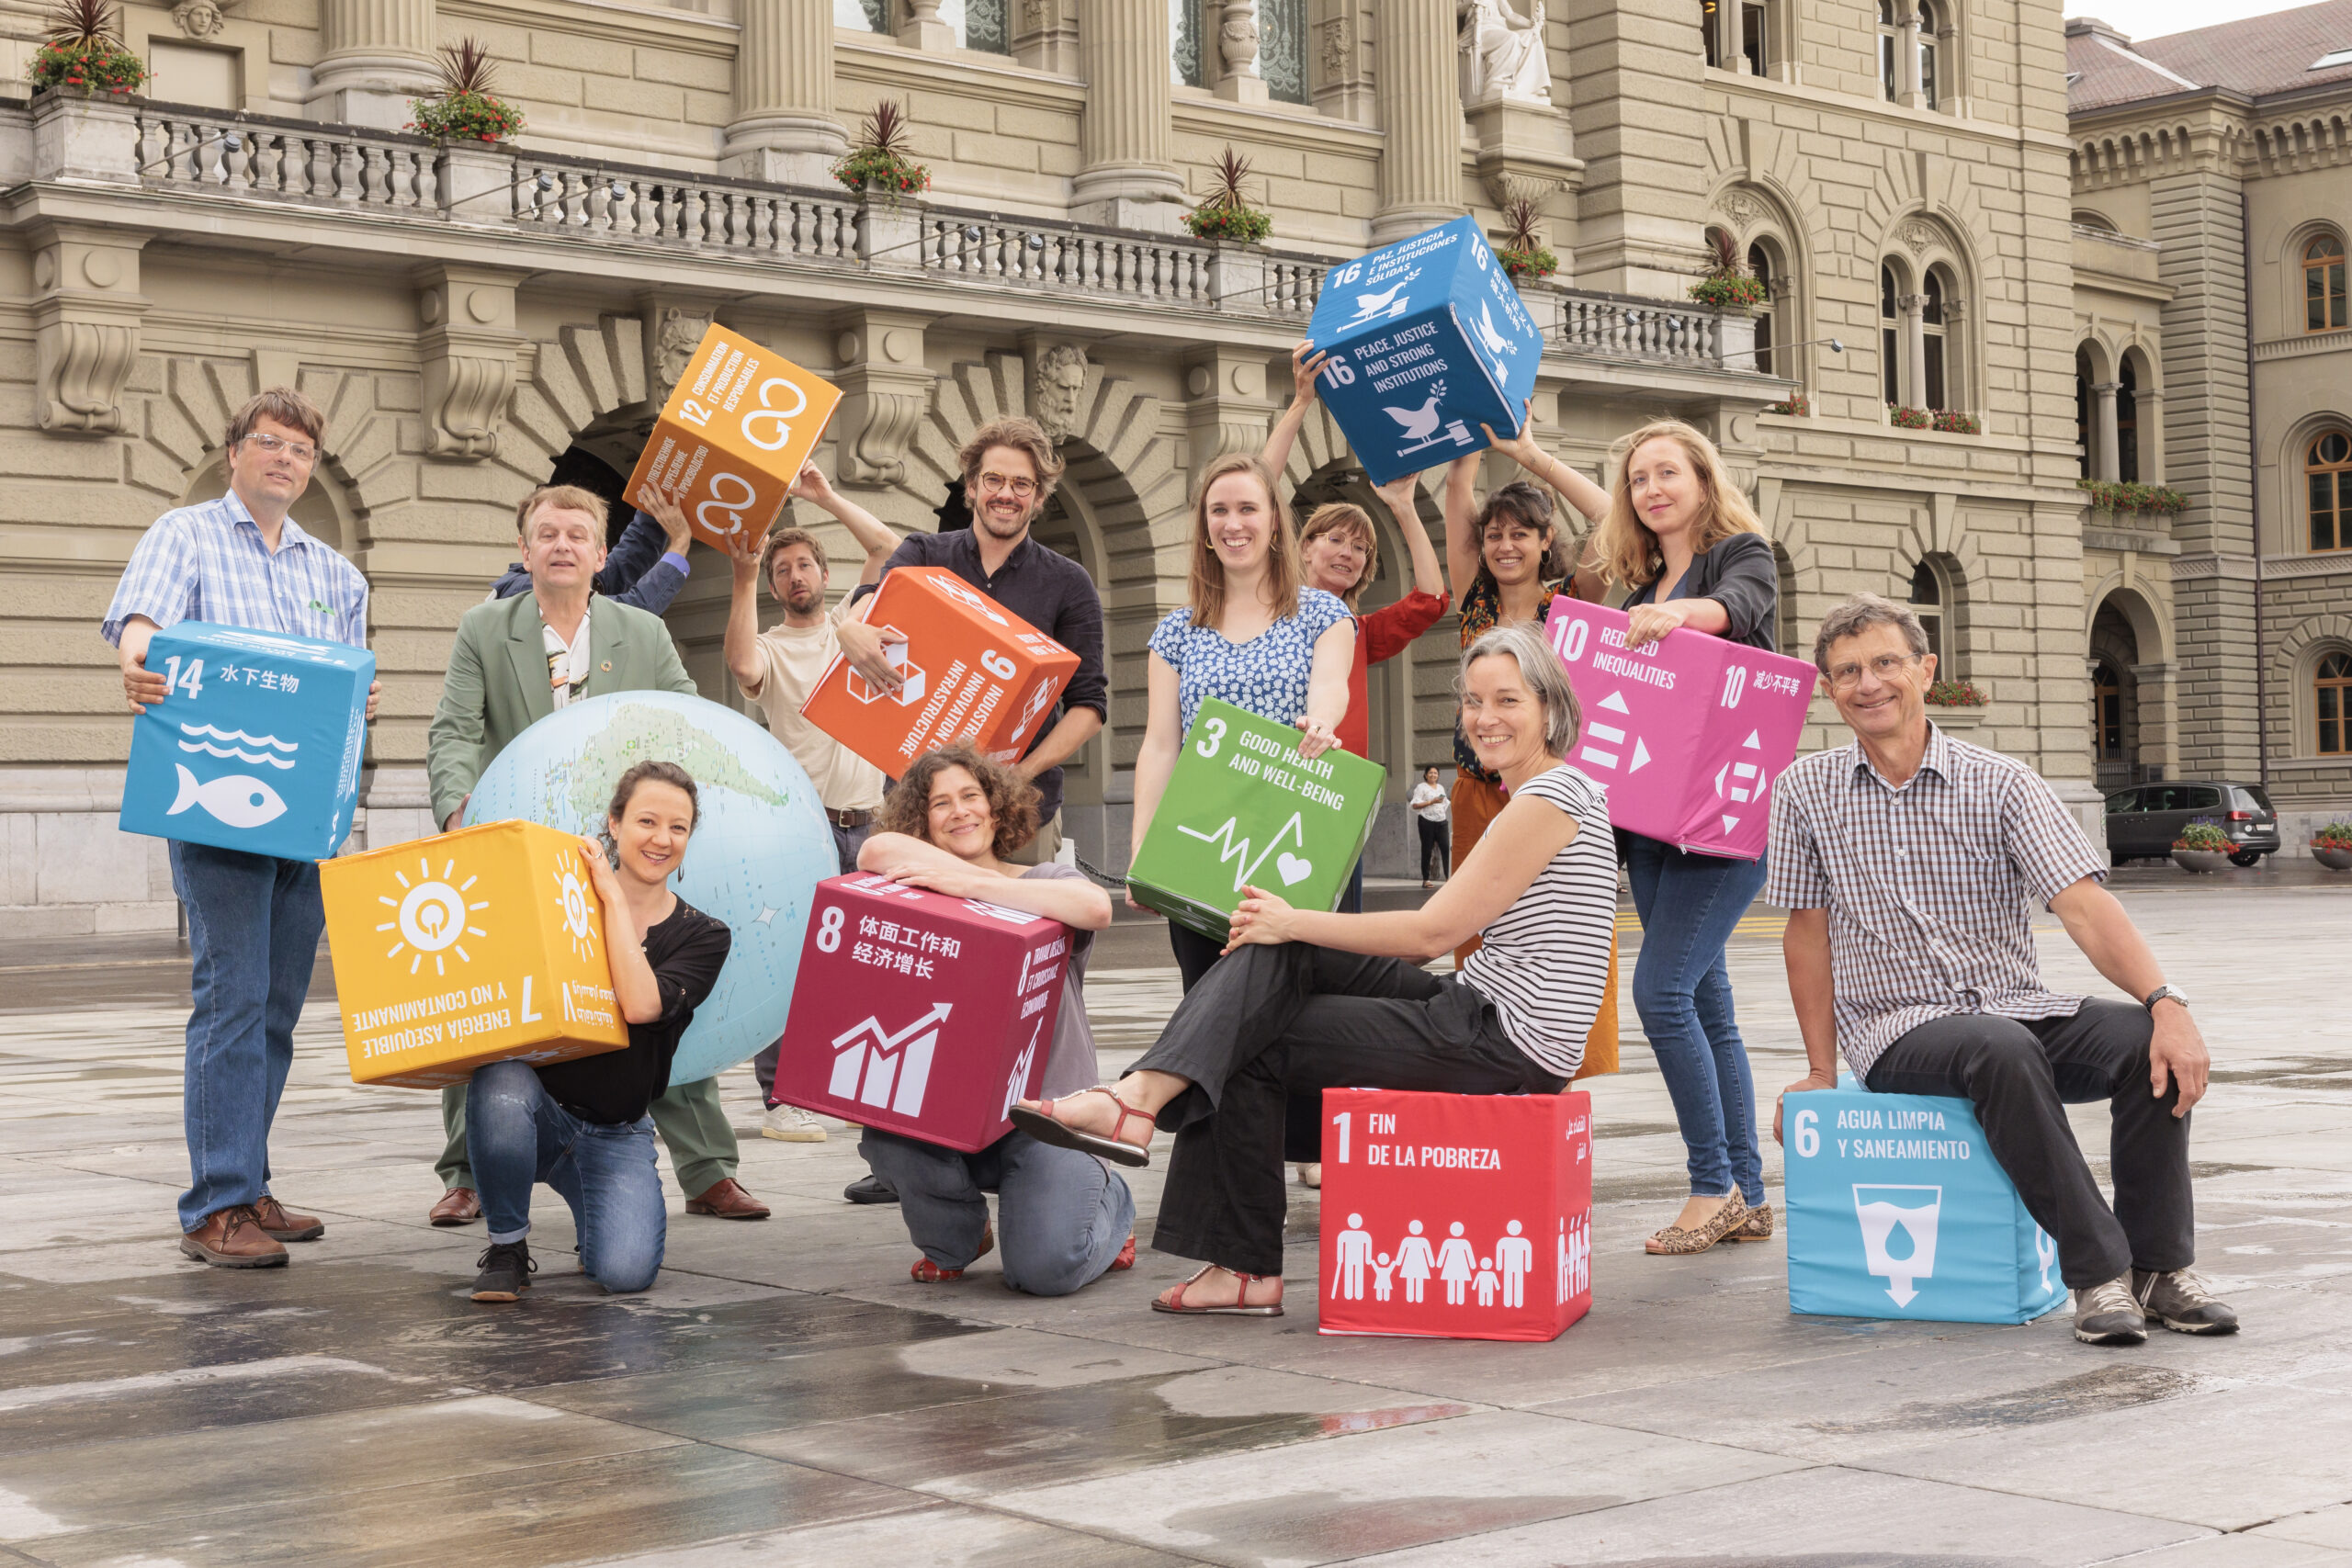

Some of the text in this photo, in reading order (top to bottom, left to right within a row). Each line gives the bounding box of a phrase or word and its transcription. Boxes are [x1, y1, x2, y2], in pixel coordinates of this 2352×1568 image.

[1368, 233, 1458, 276] E INSTITUCIONES
[1373, 231, 1444, 265] PAZ, JUSTICIA
[1472, 232, 1488, 271] 16
[1334, 263, 1363, 288] 16
[1365, 263, 1411, 287] SÓLIDAS
[1489, 277, 1521, 332] 强大机构
[1353, 321, 1439, 361] PEACE, JUSTICE
[1364, 343, 1435, 378] AND STRONG
[692, 341, 729, 396] CONSOMMATION
[707, 349, 745, 405] ET PRODUCTION
[722, 357, 760, 412] RESPONSABLES
[1320, 355, 1355, 389] 16
[1374, 359, 1448, 394] INSTITUTIONS
[679, 399, 713, 427] 12
[1554, 615, 1589, 662] 10
[164, 656, 205, 699] 14
[220, 664, 300, 694] 水下生物
[980, 649, 1017, 681] 9
[1592, 651, 1676, 689] INEQUALITIES
[1753, 671, 1801, 697] 减少不平等
[935, 671, 986, 741] INNOVATION
[1721, 665, 1747, 709] 10
[899, 659, 967, 759] INFRASTRUCTURE
[1196, 717, 1227, 758] 3
[1239, 730, 1334, 780] GOOD HEALTH
[1228, 753, 1345, 811] AND WELL-BEING
[816, 906, 845, 953] 8
[858, 915, 961, 960] 体面工作和
[852, 941, 934, 980] 经济增长
[1017, 951, 1032, 998] 8
[352, 981, 507, 1032] Y NO CONTAMINANTE
[521, 976, 542, 1024] 7
[363, 1009, 511, 1058] ENERGÍA ASEQUIBLE
[1333, 1112, 1351, 1164] 1
[1369, 1113, 1396, 1134] FIN
[1794, 1110, 1820, 1158] 6
[1838, 1110, 1945, 1131] AGUA LIMPIA
[1368, 1145, 1501, 1170] DE LA POBREZA
[1838, 1139, 1970, 1159] Y SANEAMIENTO
